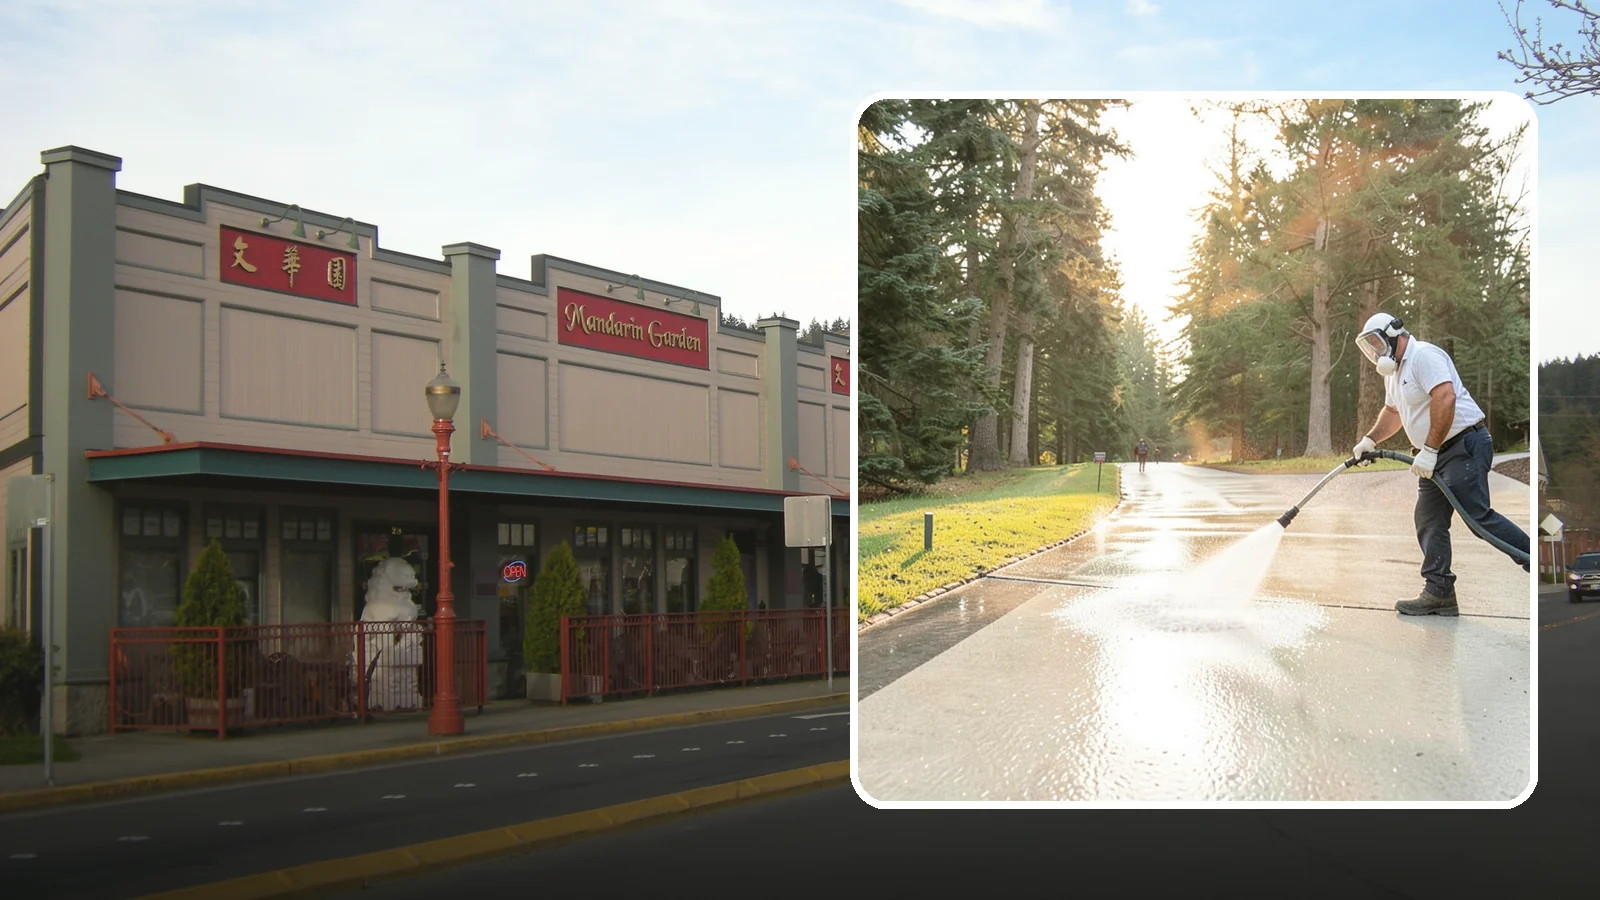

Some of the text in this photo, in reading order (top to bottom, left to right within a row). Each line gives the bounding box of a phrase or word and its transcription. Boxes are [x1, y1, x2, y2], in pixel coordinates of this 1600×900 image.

[231, 236, 346, 290] 文華園
[564, 302, 702, 352] Mandarin Garden
[503, 565, 526, 578] OPEN
